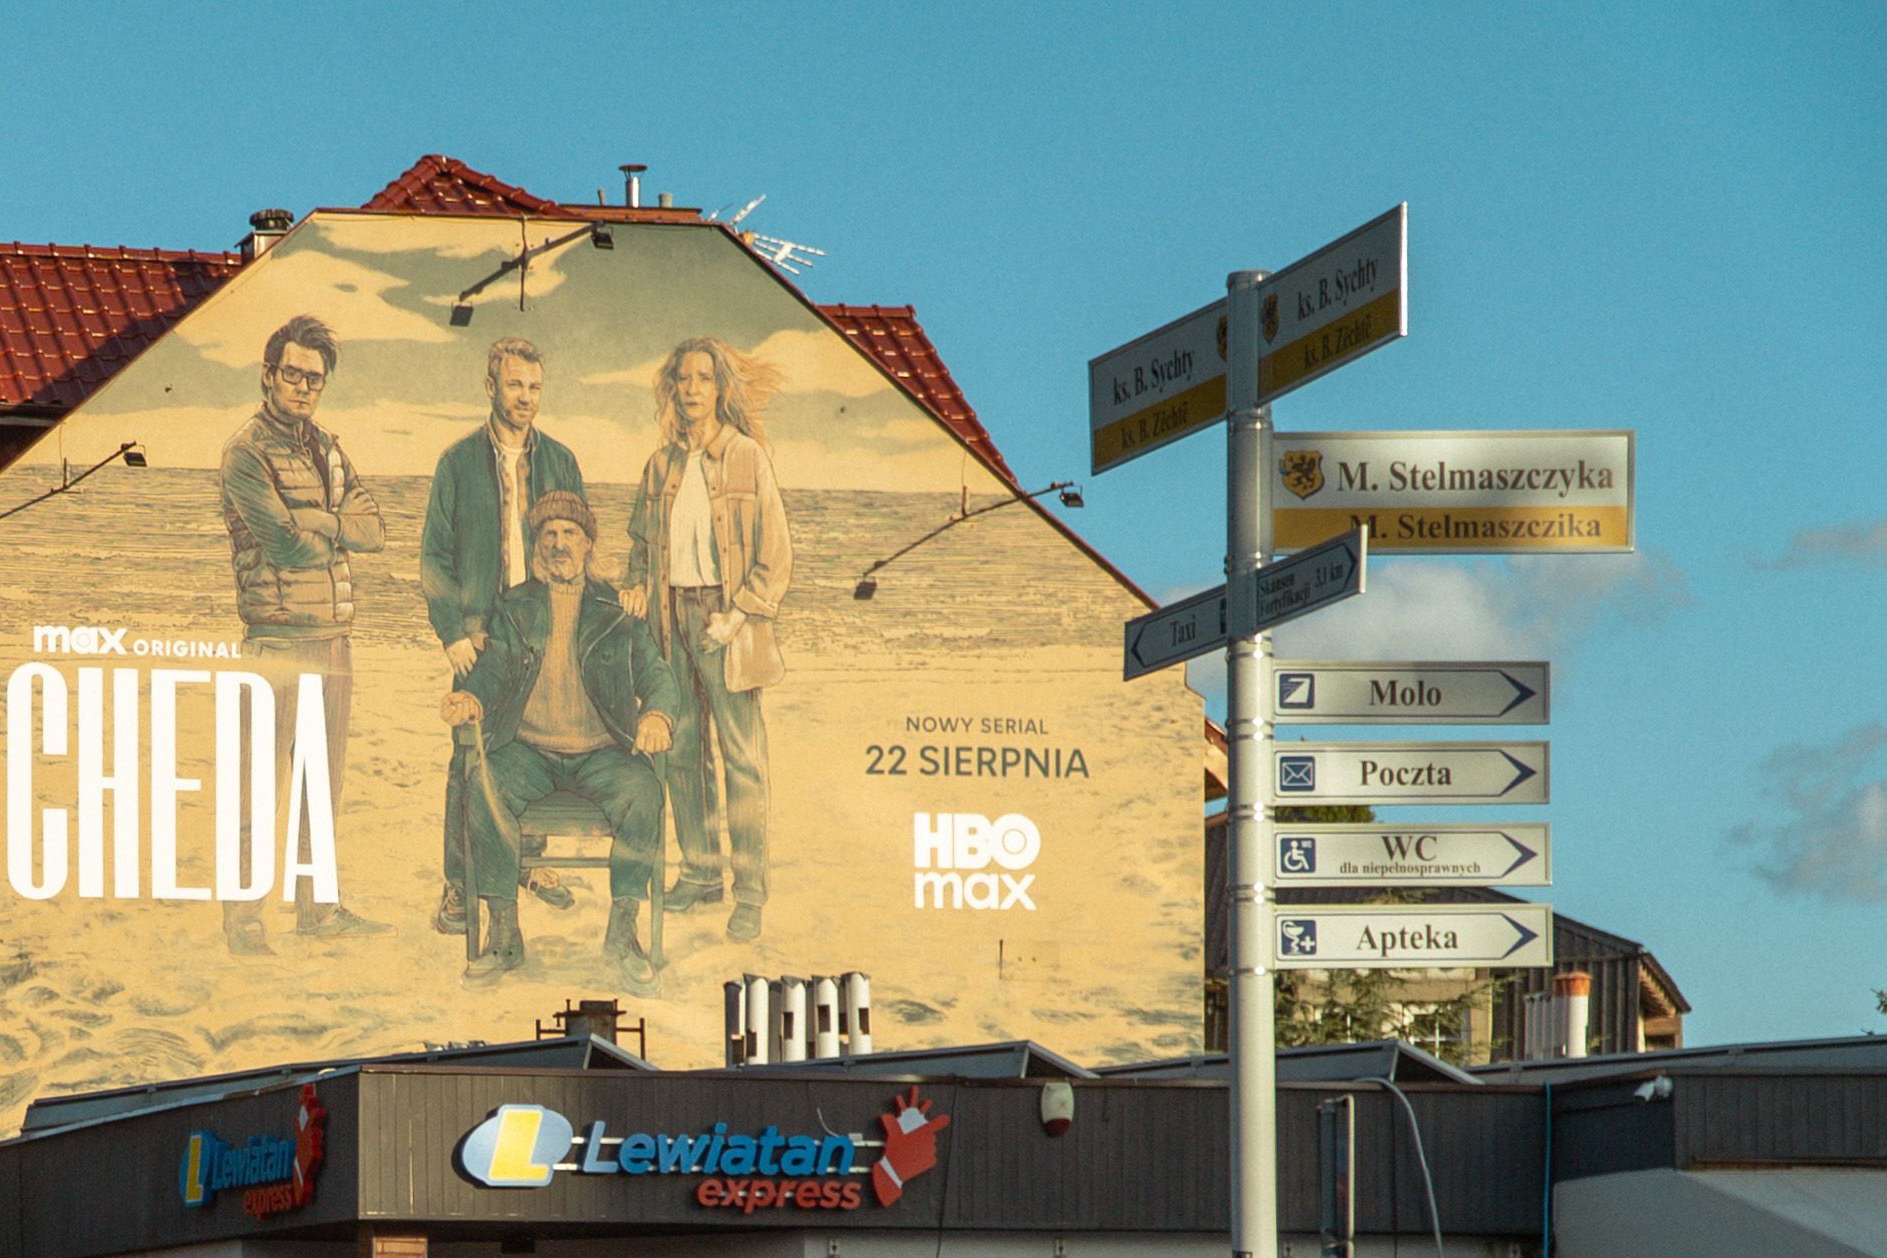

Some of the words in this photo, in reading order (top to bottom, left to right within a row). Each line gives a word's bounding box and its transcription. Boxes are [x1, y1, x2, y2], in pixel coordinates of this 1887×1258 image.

[1298, 291, 1315, 321] ks.
[1319, 278, 1332, 309] B.
[1335, 258, 1379, 307] Sychty
[1112, 379, 1131, 406] ks.
[1134, 366, 1148, 397] B.
[1151, 349, 1196, 393] Sychty
[1337, 461, 1378, 492] M.
[1389, 459, 1615, 499] Stelmaszczyka
[1396, 513, 1603, 541] Stelmaszczika
[33, 624, 127, 656] max
[133, 638, 242, 660] ORIGINAL
[1170, 615, 1197, 647] Taxi
[1369, 679, 1443, 707] Molo
[906, 716, 974, 734] NOWY
[980, 717, 1049, 735] SERIAL
[865, 744, 908, 776] 22
[919, 745, 1090, 779] SIERPNIA
[1360, 759, 1453, 787] Poczta
[914, 812, 1042, 870] HBO
[1382, 834, 1438, 862] WC
[1339, 862, 1359, 874] dla
[915, 872, 1037, 911] max
[1355, 923, 1459, 957] Apteka
[211, 1134, 296, 1190] Lewiatan
[582, 1118, 856, 1176] Lewiatan
[243, 1182, 294, 1221] express
[695, 1176, 862, 1215] express
